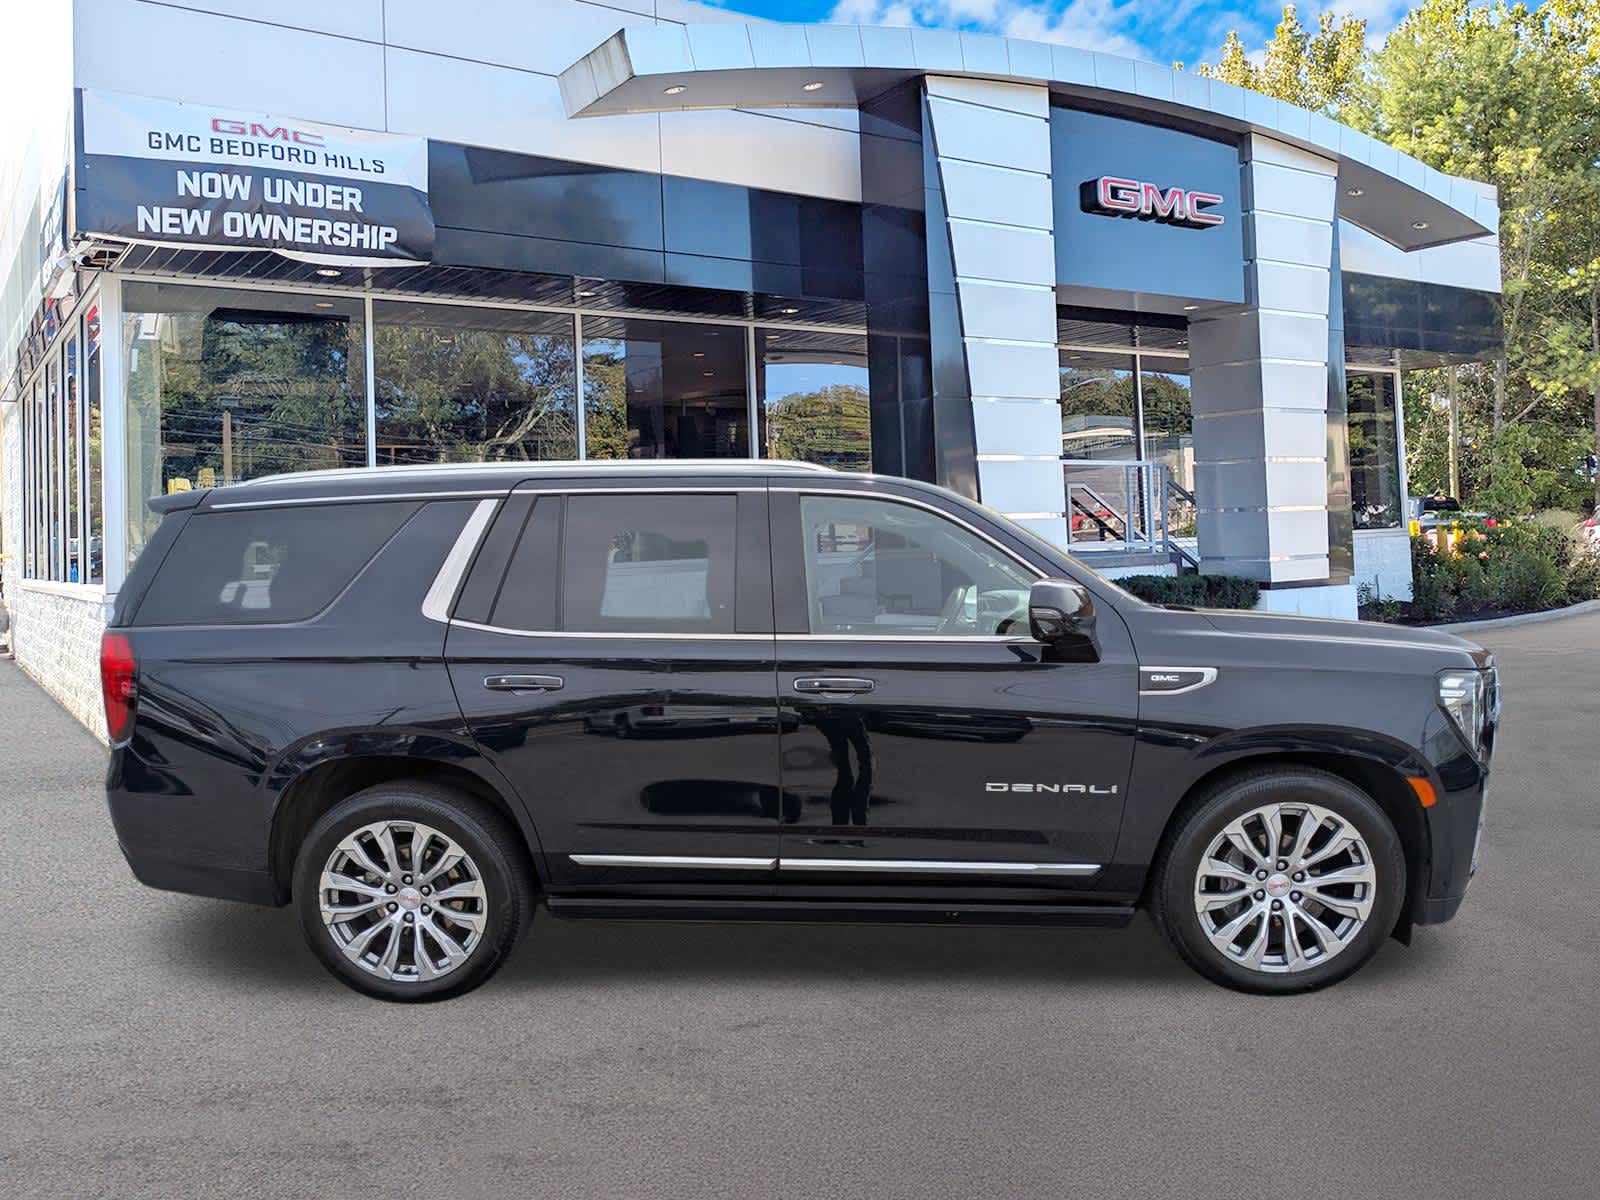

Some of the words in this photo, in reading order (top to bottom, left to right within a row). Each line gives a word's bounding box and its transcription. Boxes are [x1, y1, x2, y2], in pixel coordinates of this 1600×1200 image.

[147, 130, 201, 153] GMC
[210, 138, 317, 166] BEDFORD
[325, 153, 385, 175] HILLS
[211, 118, 326, 148] GMC
[176, 170, 252, 201] NOW
[263, 177, 364, 213] UNDER
[1096, 175, 1225, 225] GMC
[136, 205, 211, 236] NEW
[223, 211, 398, 250] OWNERSHIP
[1150, 674, 1180, 682] GMC
[985, 782, 1118, 794] DENALI
